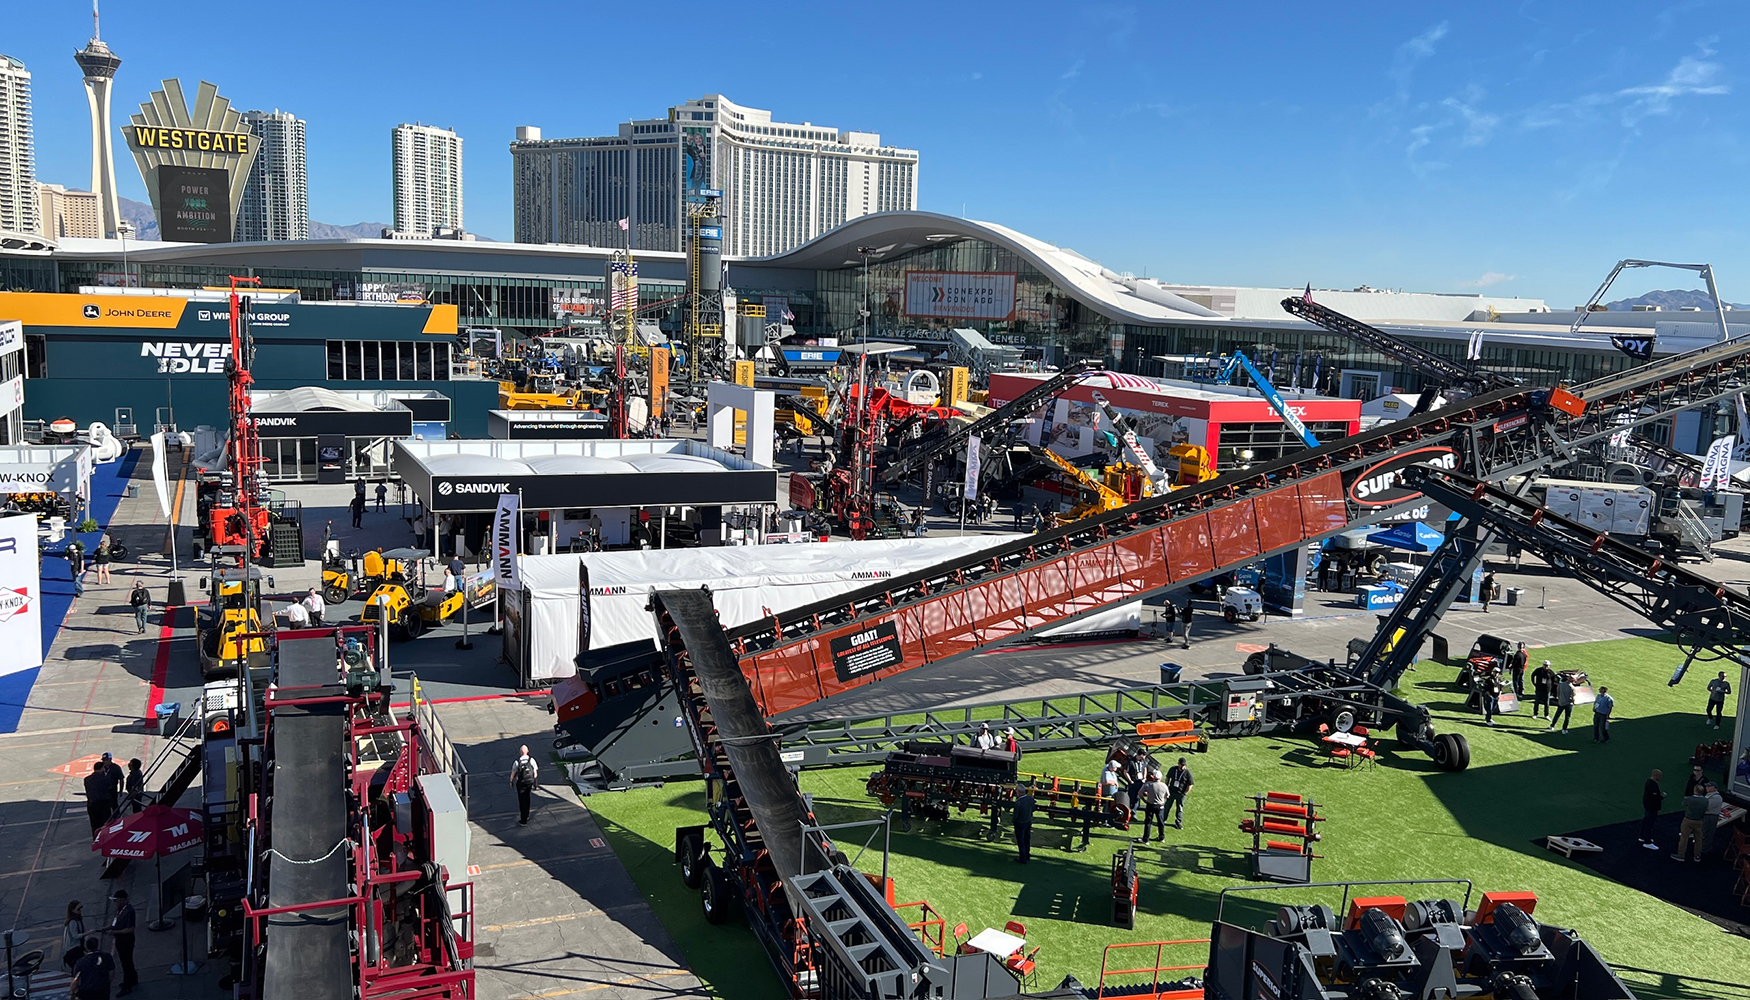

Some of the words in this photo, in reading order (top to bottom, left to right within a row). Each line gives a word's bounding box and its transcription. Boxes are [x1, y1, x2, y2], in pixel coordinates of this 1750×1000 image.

[136, 127, 248, 153] WESTGATE
[181, 185, 209, 195] POWER
[177, 211, 216, 221] AMBITION
[700, 229, 718, 237] ERIE
[912, 275, 944, 283] WELCOME
[356, 283, 385, 292] HAPPY
[947, 287, 993, 296] CONEXPO
[356, 292, 399, 301] BIRTHDAY
[105, 308, 135, 317] JOHN
[136, 309, 172, 318] DEERE
[933, 305, 976, 313] BIENVENIDOS
[257, 313, 290, 321] GROUP
[876, 328, 892, 338] LAS
[894, 329, 924, 339] VEGAS
[988, 334, 1027, 344] CENTER
[801, 352, 823, 360] ERIE
[157, 357, 226, 374] IDLE
[1152, 400, 1170, 408] TEREX
[254, 417, 297, 426] SANDVIK
[1701, 444, 1720, 485] MAGNA
[1719, 442, 1730, 486] MAGNA
[455, 483, 510, 494] SANDVIK
[925, 470, 933, 500] SANDVIK
[1393, 529, 1412, 539] Genie
[498, 507, 513, 580] AMMANN
[851, 570, 891, 579] AMMANN
[1370, 593, 1394, 605] Genie
[850, 628, 879, 647] GOAT!
[166, 837, 203, 853] MASABA
[110, 848, 145, 857] MASABA
